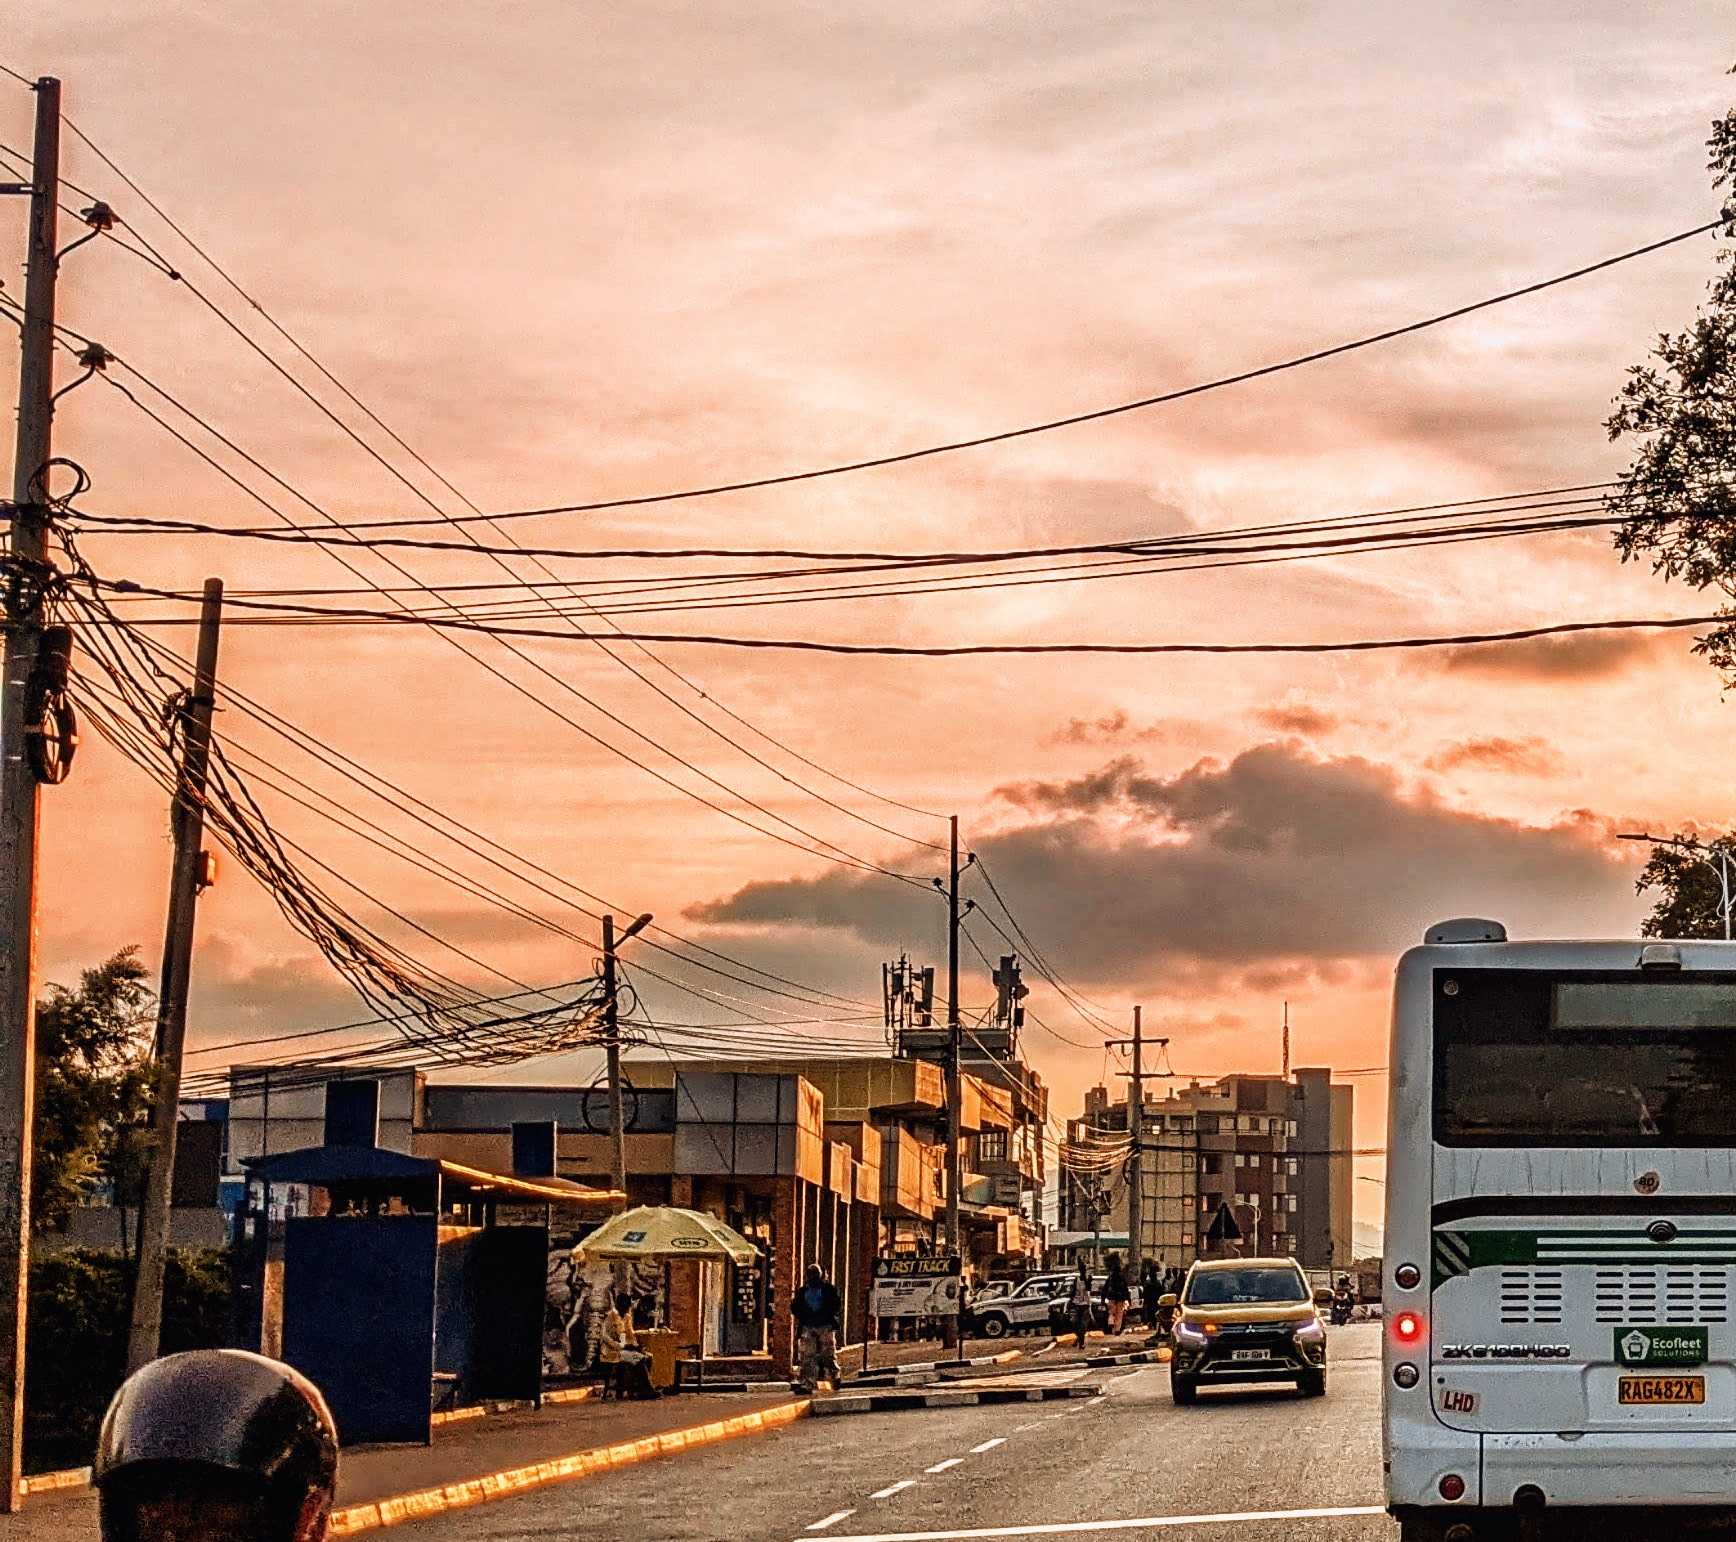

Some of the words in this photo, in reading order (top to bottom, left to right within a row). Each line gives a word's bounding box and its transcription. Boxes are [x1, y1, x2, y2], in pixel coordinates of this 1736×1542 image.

[890, 1260, 916, 1274] FAST
[918, 1259, 951, 1273] TRACK
[1652, 1337, 1702, 1349] Ecofleet
[1652, 1349, 1701, 1357] SOLUTIONS
[1621, 1381, 1695, 1401] RAG482X
[1443, 1390, 1475, 1413] LHD
